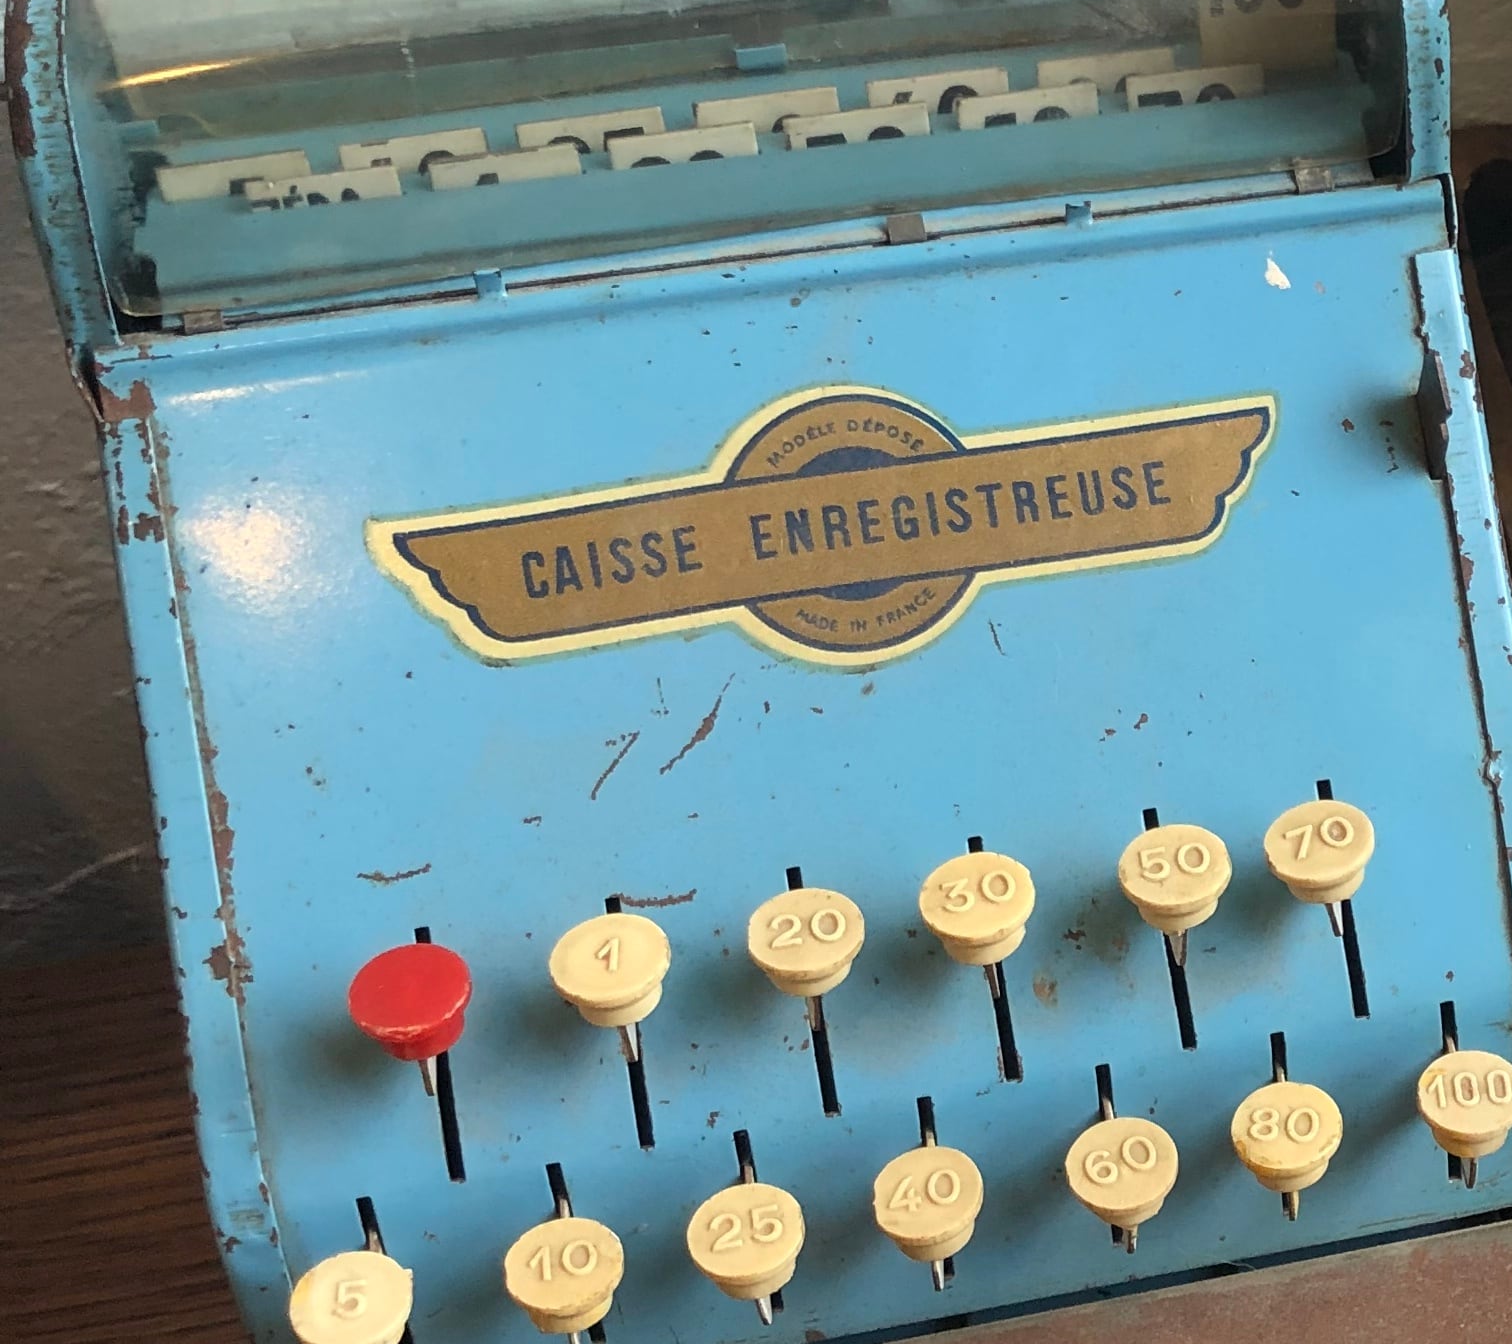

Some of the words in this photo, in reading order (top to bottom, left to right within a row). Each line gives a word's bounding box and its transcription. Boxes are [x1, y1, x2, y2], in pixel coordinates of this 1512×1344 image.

[766, 422, 836, 468] MODÈLE
[521, 525, 703, 599] CAISSE
[750, 460, 1171, 561] ENREGISTREUSE
[796, 609, 838, 632] MADE
[850, 617, 867, 632] IN
[876, 587, 936, 627] FRANCE
[596, 937, 620, 972] 1
[768, 908, 846, 949] 20
[939, 869, 1016, 912] 30
[1138, 842, 1210, 881] 50
[1283, 816, 1354, 860] 70
[333, 1279, 369, 1318] 5
[527, 1239, 597, 1281] 10
[707, 1204, 784, 1252] 25
[888, 1169, 960, 1212] 40
[1084, 1136, 1157, 1184] 60
[1248, 1108, 1320, 1143] 80
[1427, 1070, 1512, 1108] 100
